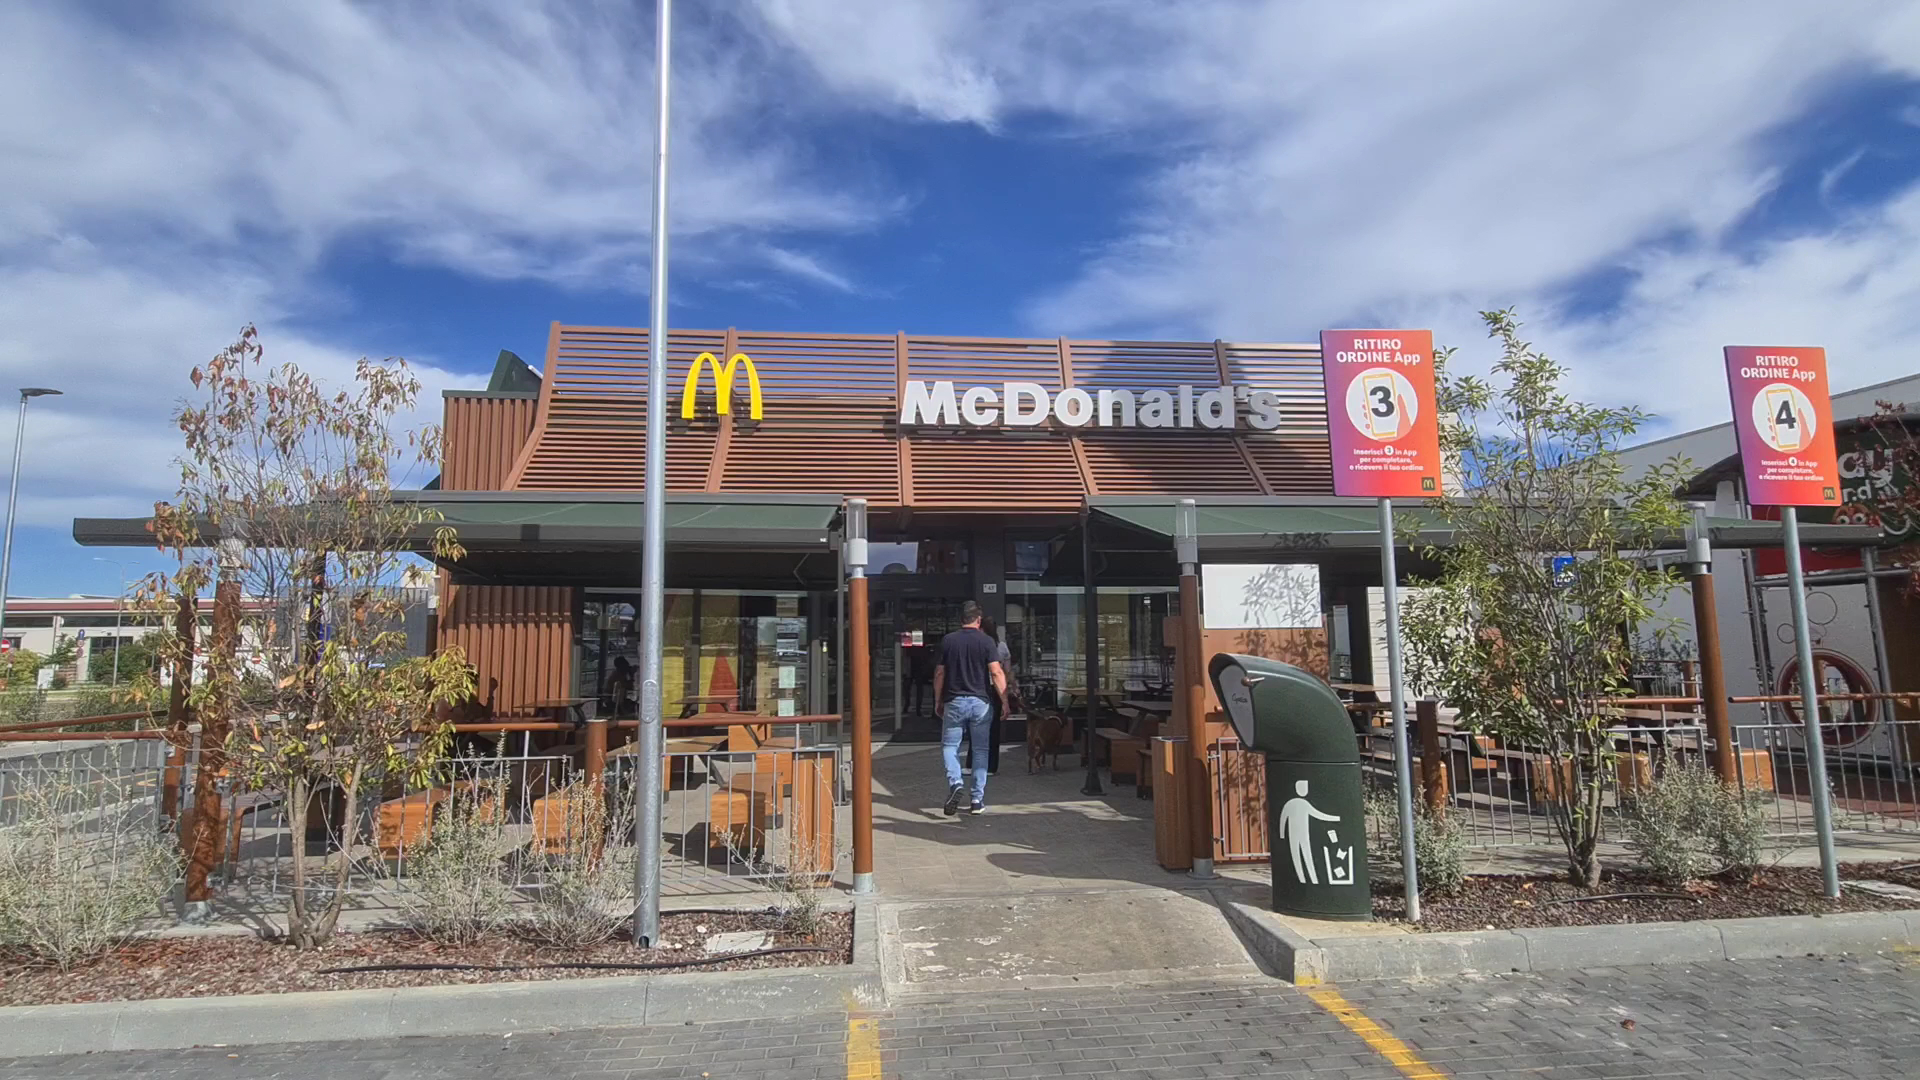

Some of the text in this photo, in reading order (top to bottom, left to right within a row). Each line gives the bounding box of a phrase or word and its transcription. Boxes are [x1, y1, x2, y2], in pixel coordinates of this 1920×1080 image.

[1353, 338, 1402, 350] RITIRO
[1336, 351, 1421, 366] ORDINE App
[1755, 355, 1799, 367] RITIRO
[1740, 367, 1816, 382] ORDINE App
[900, 380, 1281, 431] McDonald's
[1369, 385, 1395, 418] 3
[1775, 400, 1797, 429] 4
[1403, 449, 1418, 457] App
